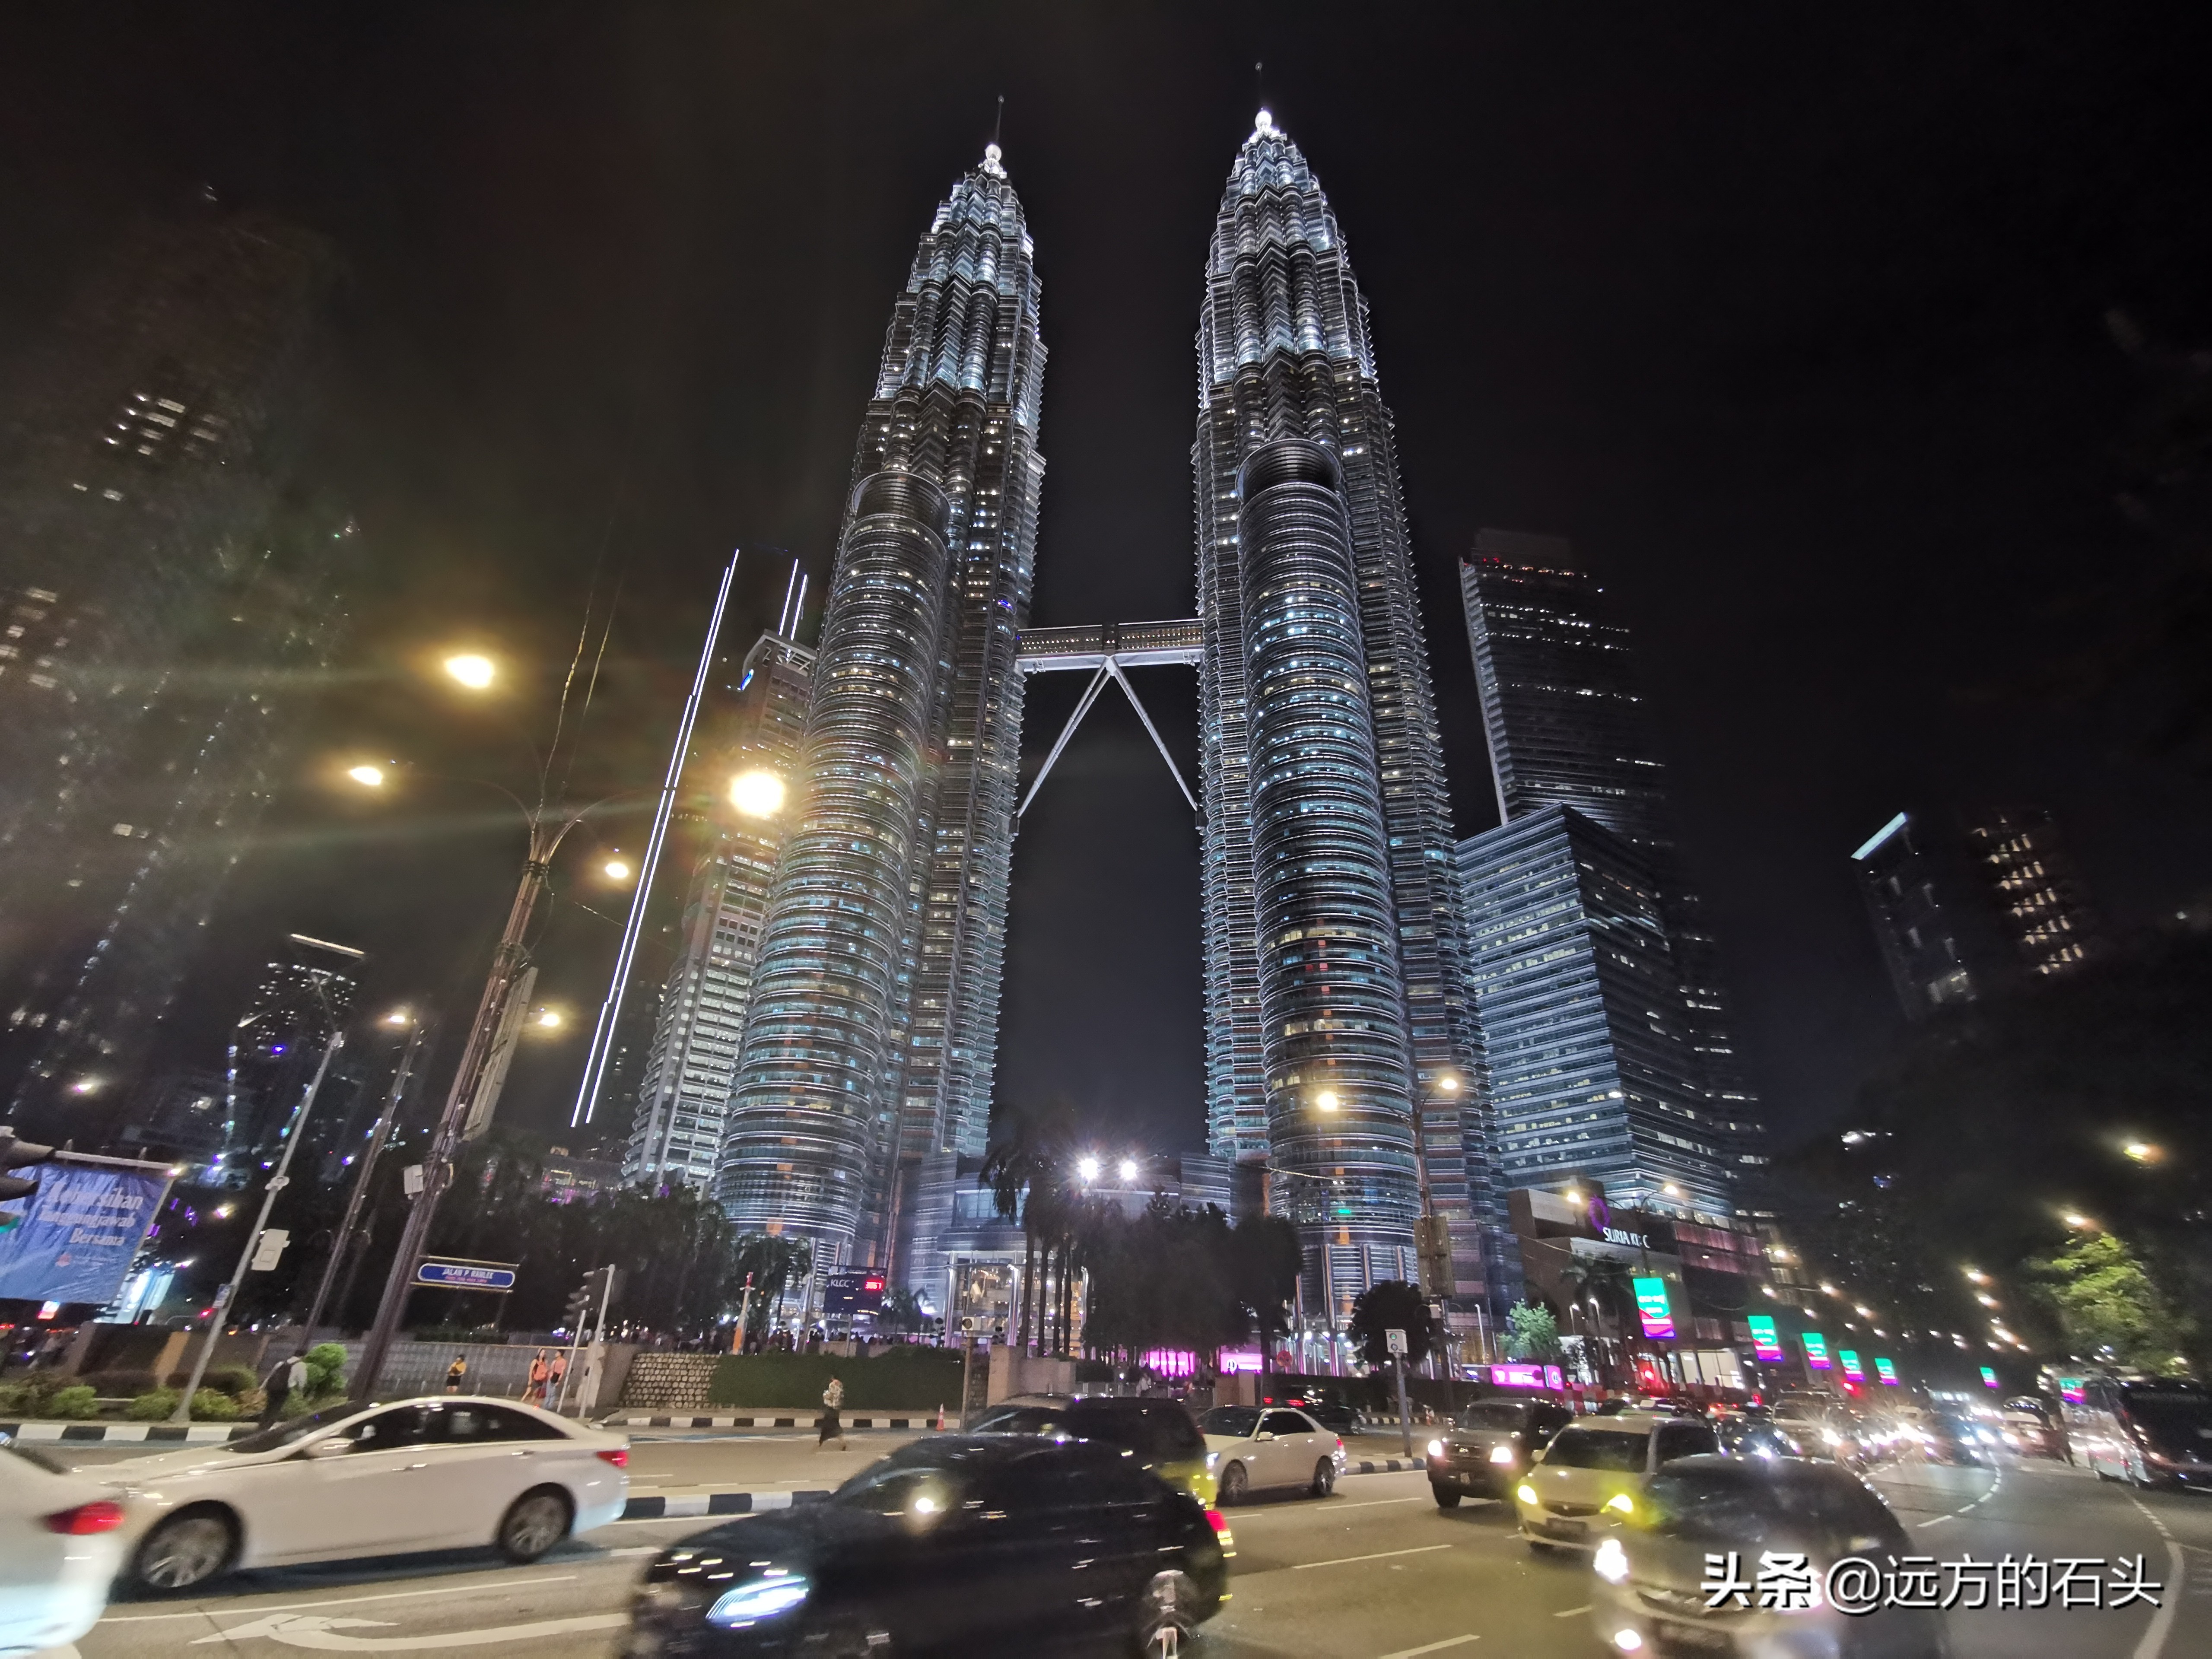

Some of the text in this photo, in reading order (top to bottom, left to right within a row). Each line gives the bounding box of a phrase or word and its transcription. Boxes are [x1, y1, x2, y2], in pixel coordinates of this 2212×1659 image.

[69, 1228, 126, 1246] Bersama
[1602, 1227, 1650, 1248] SURIA KLC
[830, 1278, 850, 1288] KLCC
